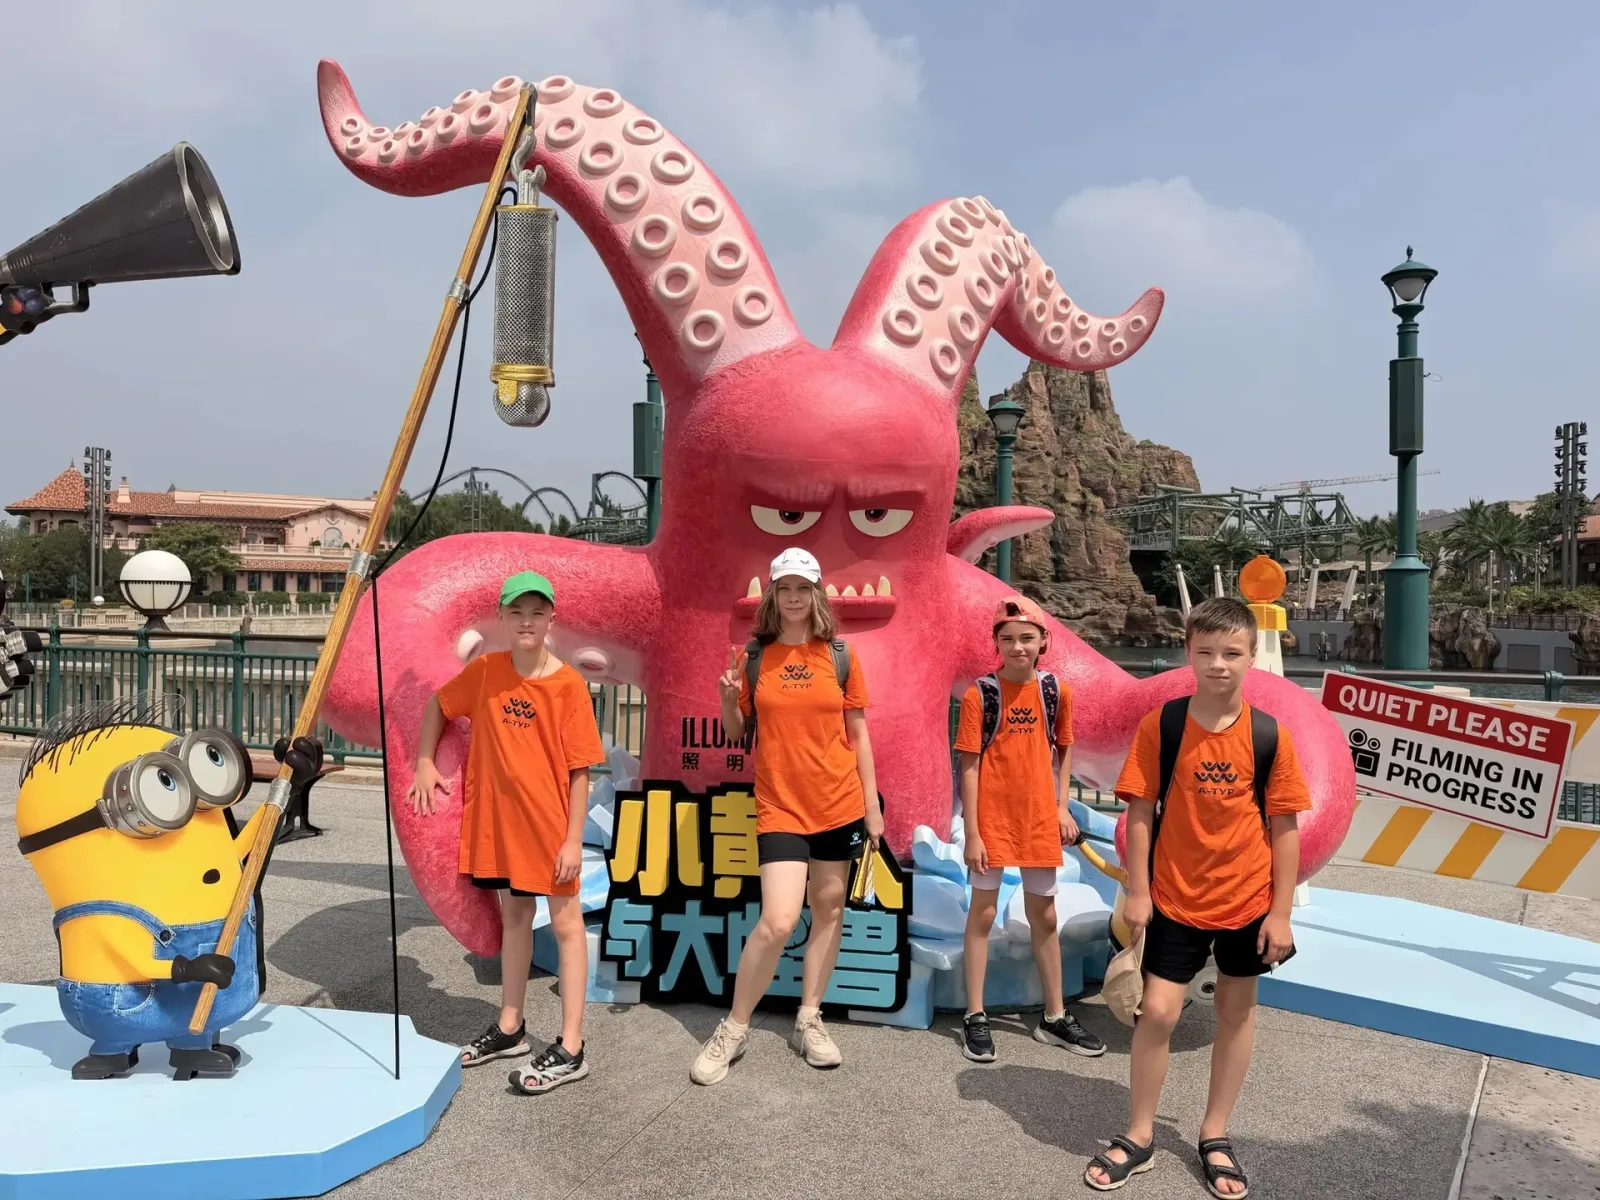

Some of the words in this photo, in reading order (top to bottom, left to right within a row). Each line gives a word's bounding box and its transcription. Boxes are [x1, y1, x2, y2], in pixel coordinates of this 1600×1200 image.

[1339, 685, 1423, 722] QUIET
[1427, 703, 1550, 753] PLEASE
[1386, 762, 1537, 820] PROGRESS
[1391, 737, 1504, 784] FILMING
[1511, 767, 1544, 794] IN
